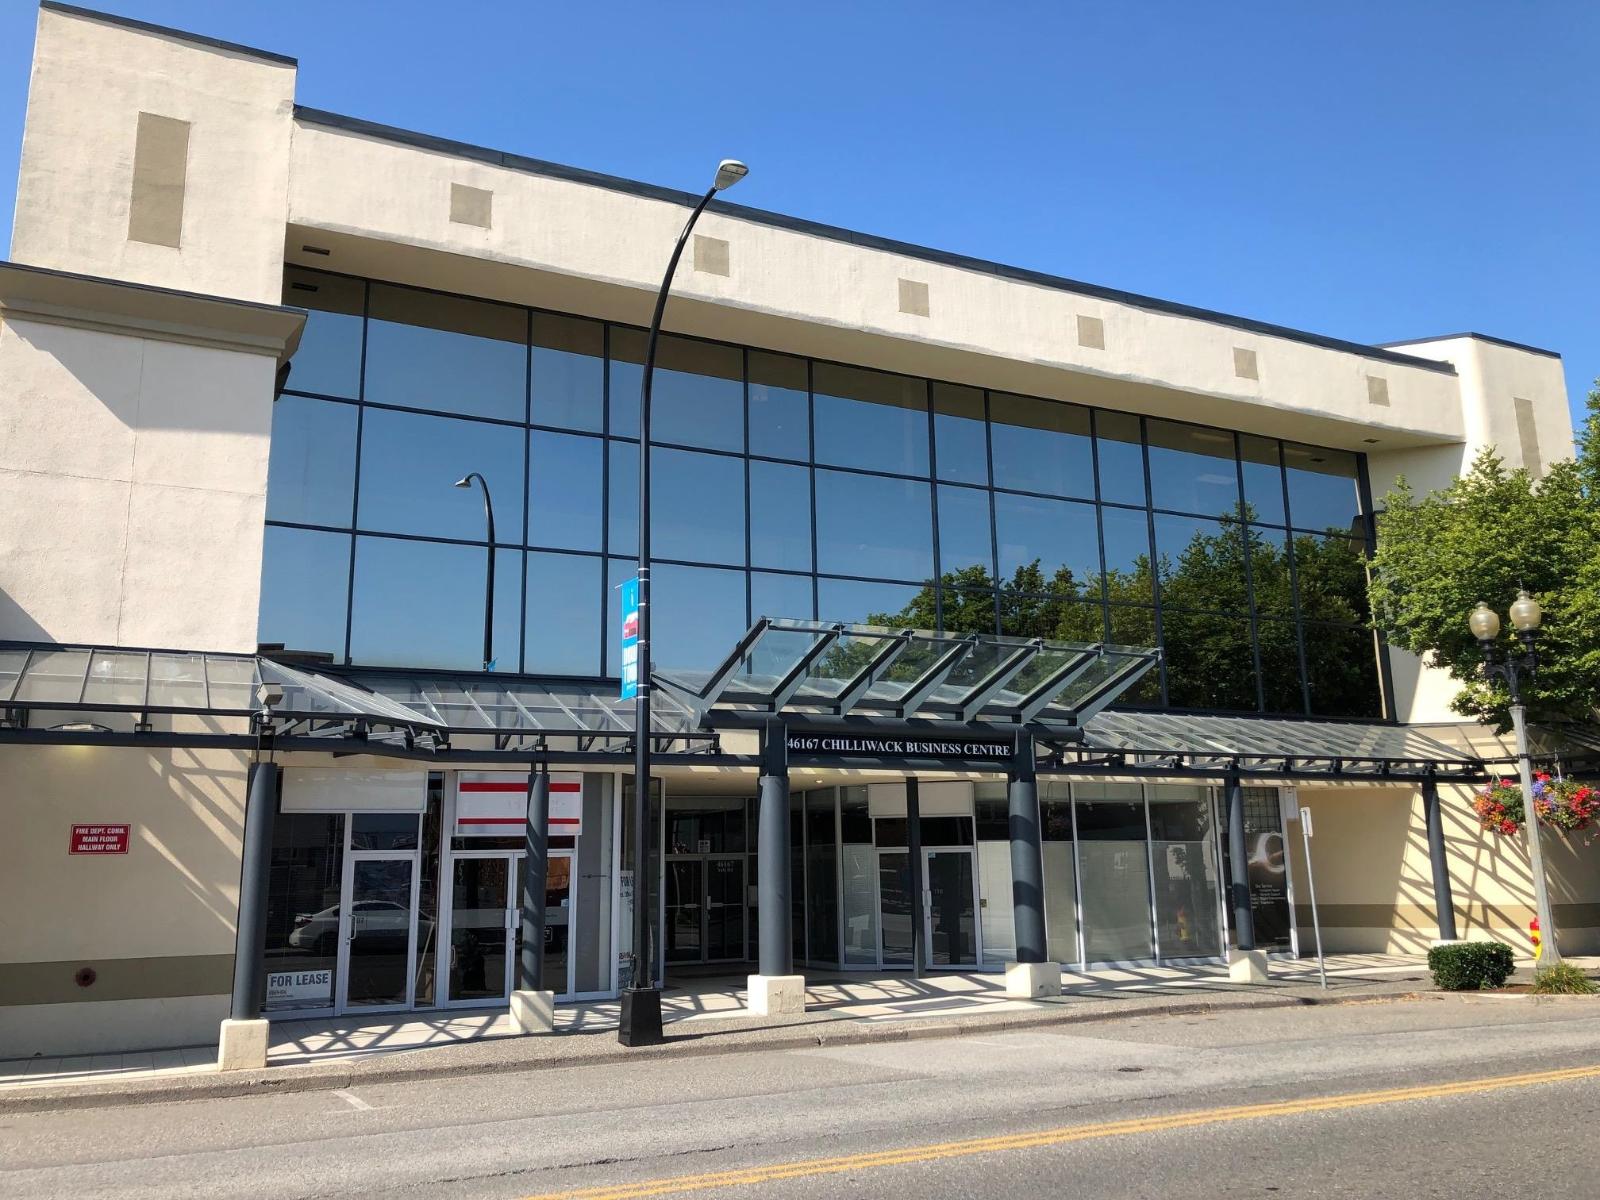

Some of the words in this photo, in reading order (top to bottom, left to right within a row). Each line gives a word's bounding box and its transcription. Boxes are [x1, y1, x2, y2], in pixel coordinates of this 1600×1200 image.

[787, 738, 819, 749] 46167
[821, 739, 903, 753] CHILLIWACK
[906, 741, 962, 754] BUSINESS
[963, 743, 1011, 756] CENTRE
[270, 975, 293, 987] FOR
[296, 973, 329, 985] LEASE
